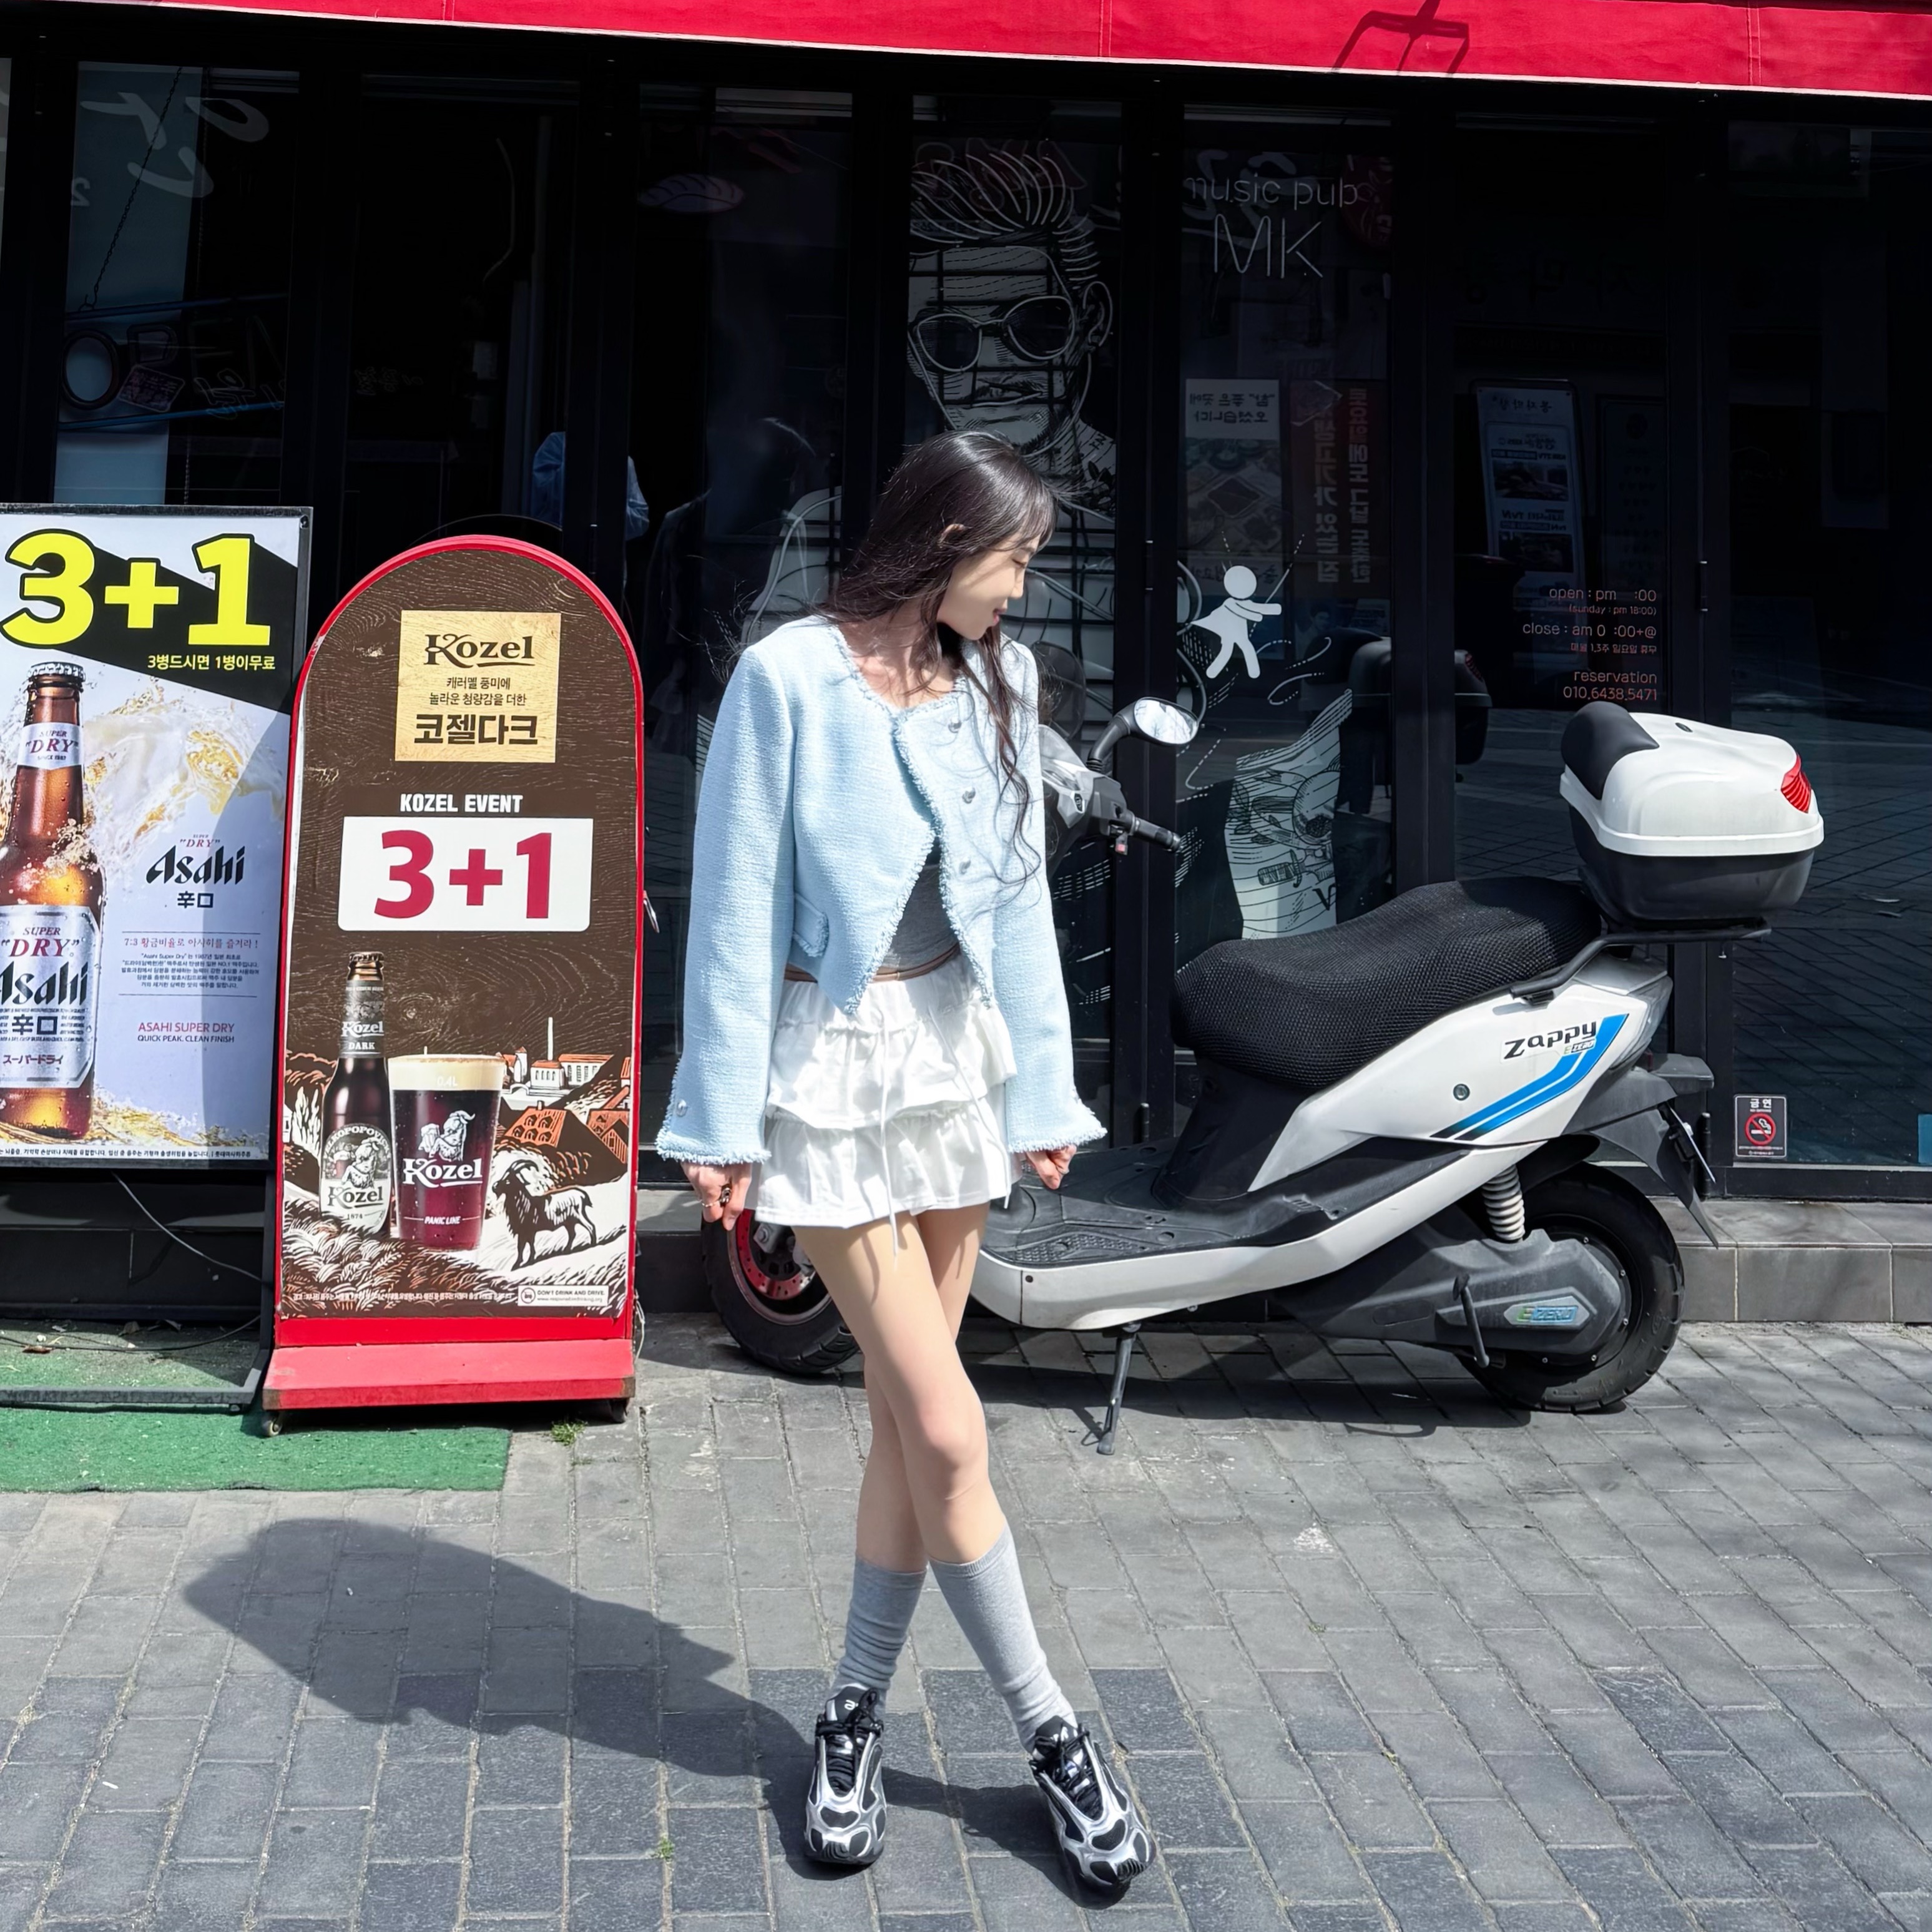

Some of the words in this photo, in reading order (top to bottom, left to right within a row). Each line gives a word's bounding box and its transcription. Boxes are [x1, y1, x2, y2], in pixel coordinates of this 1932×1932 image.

[1185, 174, 1281, 205] music
[1294, 177, 1358, 210] pub
[1214, 213, 1323, 278] MK
[1, 529, 271, 648] 3+1
[1549, 588, 1584, 602] open
[1596, 590, 1617, 602] pm
[1522, 622, 1560, 635] close
[1572, 625, 1592, 636] am
[424, 634, 536, 669] Kozel
[148, 654, 209, 670] 3병드시면
[215, 654, 275, 671] 1병이무료
[446, 677, 477, 690] 캐러멜
[480, 677, 511, 690] 풍미에
[1574, 671, 1657, 684] reservation
[429, 692, 459, 706] 놀라운
[463, 693, 504, 707] 청량감을
[506, 693, 527, 707] 더한
[1563, 686, 1657, 702] 010.6438.5471
[414, 713, 538, 745] 코젤다크
[400, 793, 459, 813] KOZEL
[464, 794, 523, 813] EVENT
[146, 845, 245, 885] Asahi
[374, 829, 552, 919] 3+1
[177, 891, 213, 909] 辛口
[22, 927, 61, 936] SUPER
[124, 938, 138, 946] 7:3
[141, 937, 185, 948] 황금비율로
[12, 1014, 58, 1036] 辛口
[138, 1022, 173, 1032] ASAHI
[174, 1022, 210, 1033] SUPER
[212, 1022, 235, 1033] DRY
[340, 1021, 385, 1038] Kozel
[185, 1035, 209, 1043] CLEAN
[348, 1042, 376, 1050] DARK
[1504, 1021, 1597, 1060] Zappy
[2, 1054, 64, 1065] スーパードライ
[403, 1158, 483, 1188] Kozel
[328, 1186, 384, 1210] Kozel
